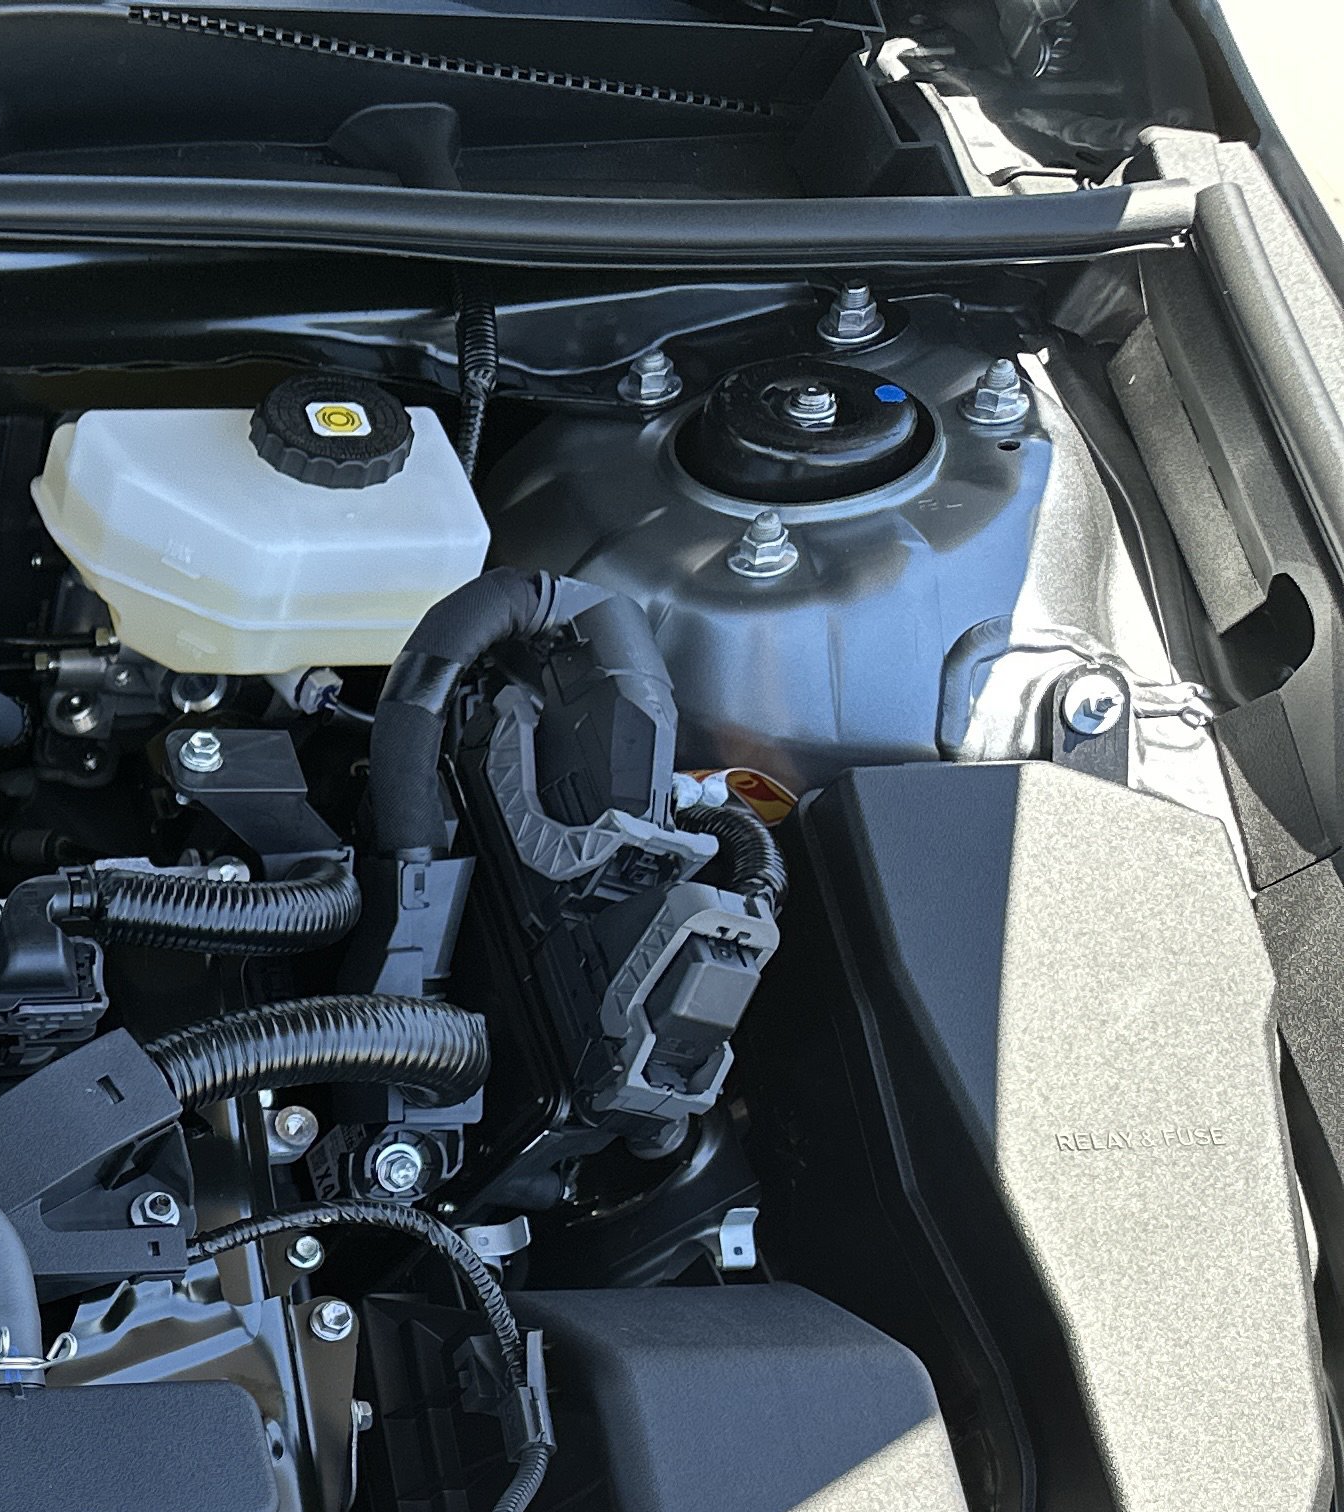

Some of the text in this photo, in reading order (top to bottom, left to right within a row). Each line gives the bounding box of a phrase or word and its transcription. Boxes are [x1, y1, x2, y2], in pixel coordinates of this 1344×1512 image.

[1054, 1128, 1226, 1151] RELAY & FUSE
